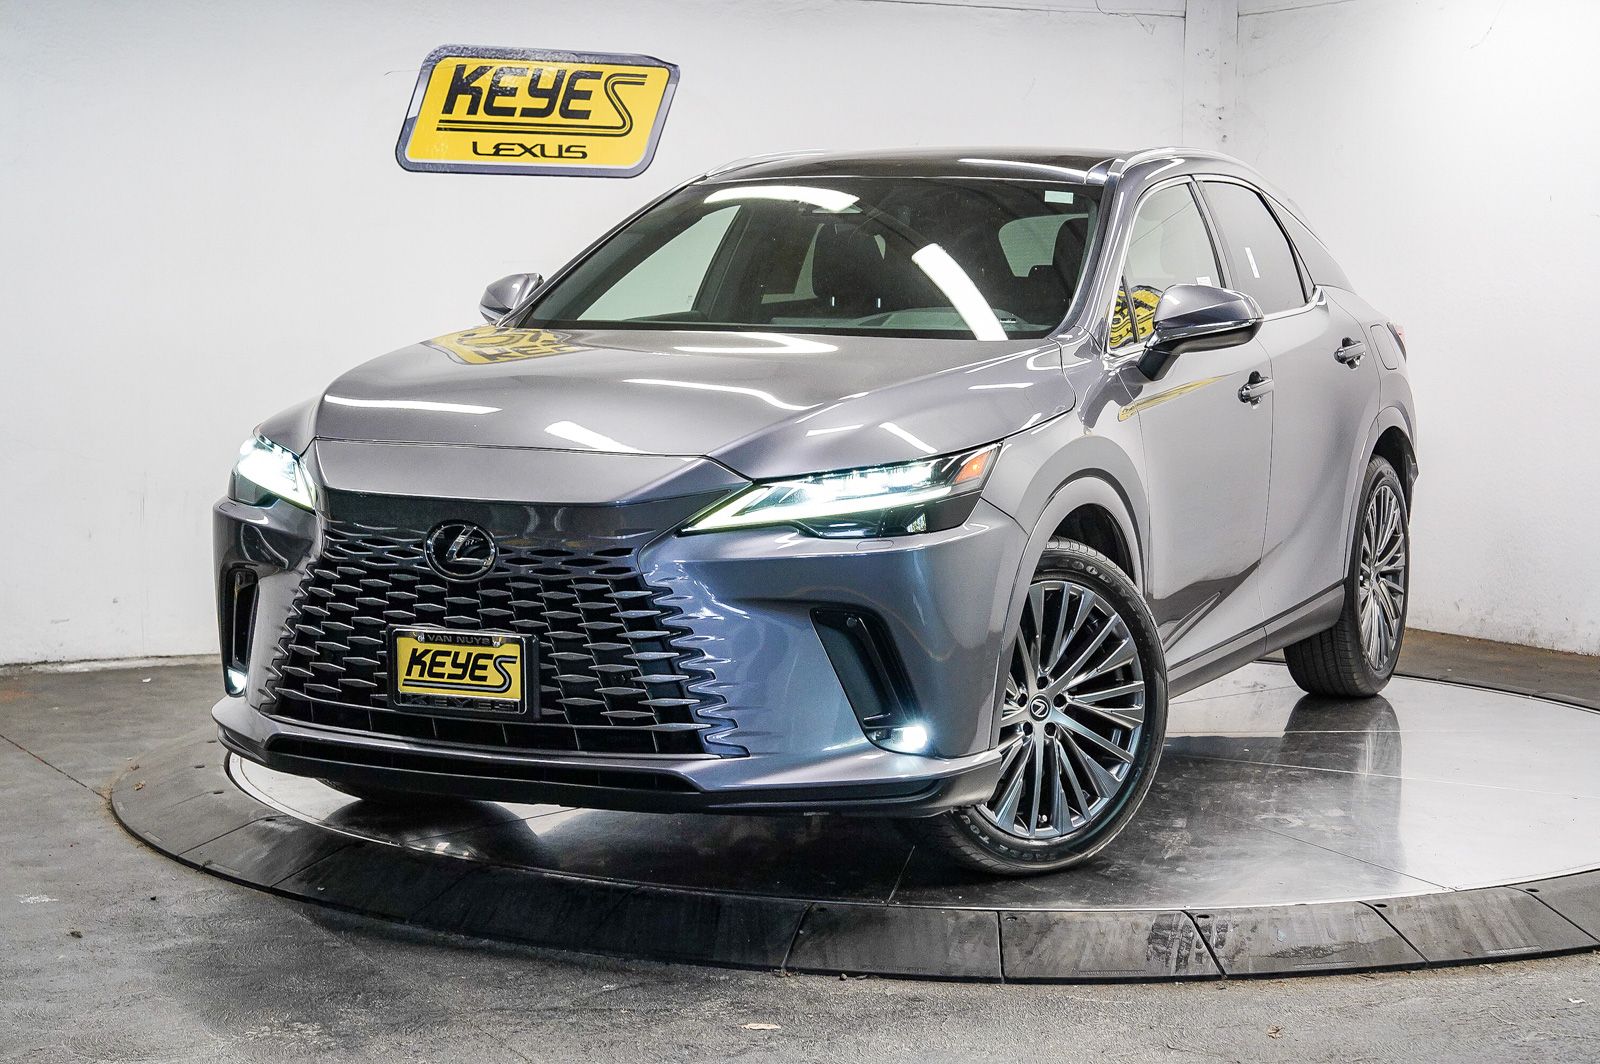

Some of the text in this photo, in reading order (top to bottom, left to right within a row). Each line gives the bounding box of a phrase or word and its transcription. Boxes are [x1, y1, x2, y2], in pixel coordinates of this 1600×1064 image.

[437, 64, 648, 137] KEYES
[472, 141, 588, 159] LEXUS
[427, 634, 490, 645] VAN NUYS
[402, 648, 518, 693] KEYES
